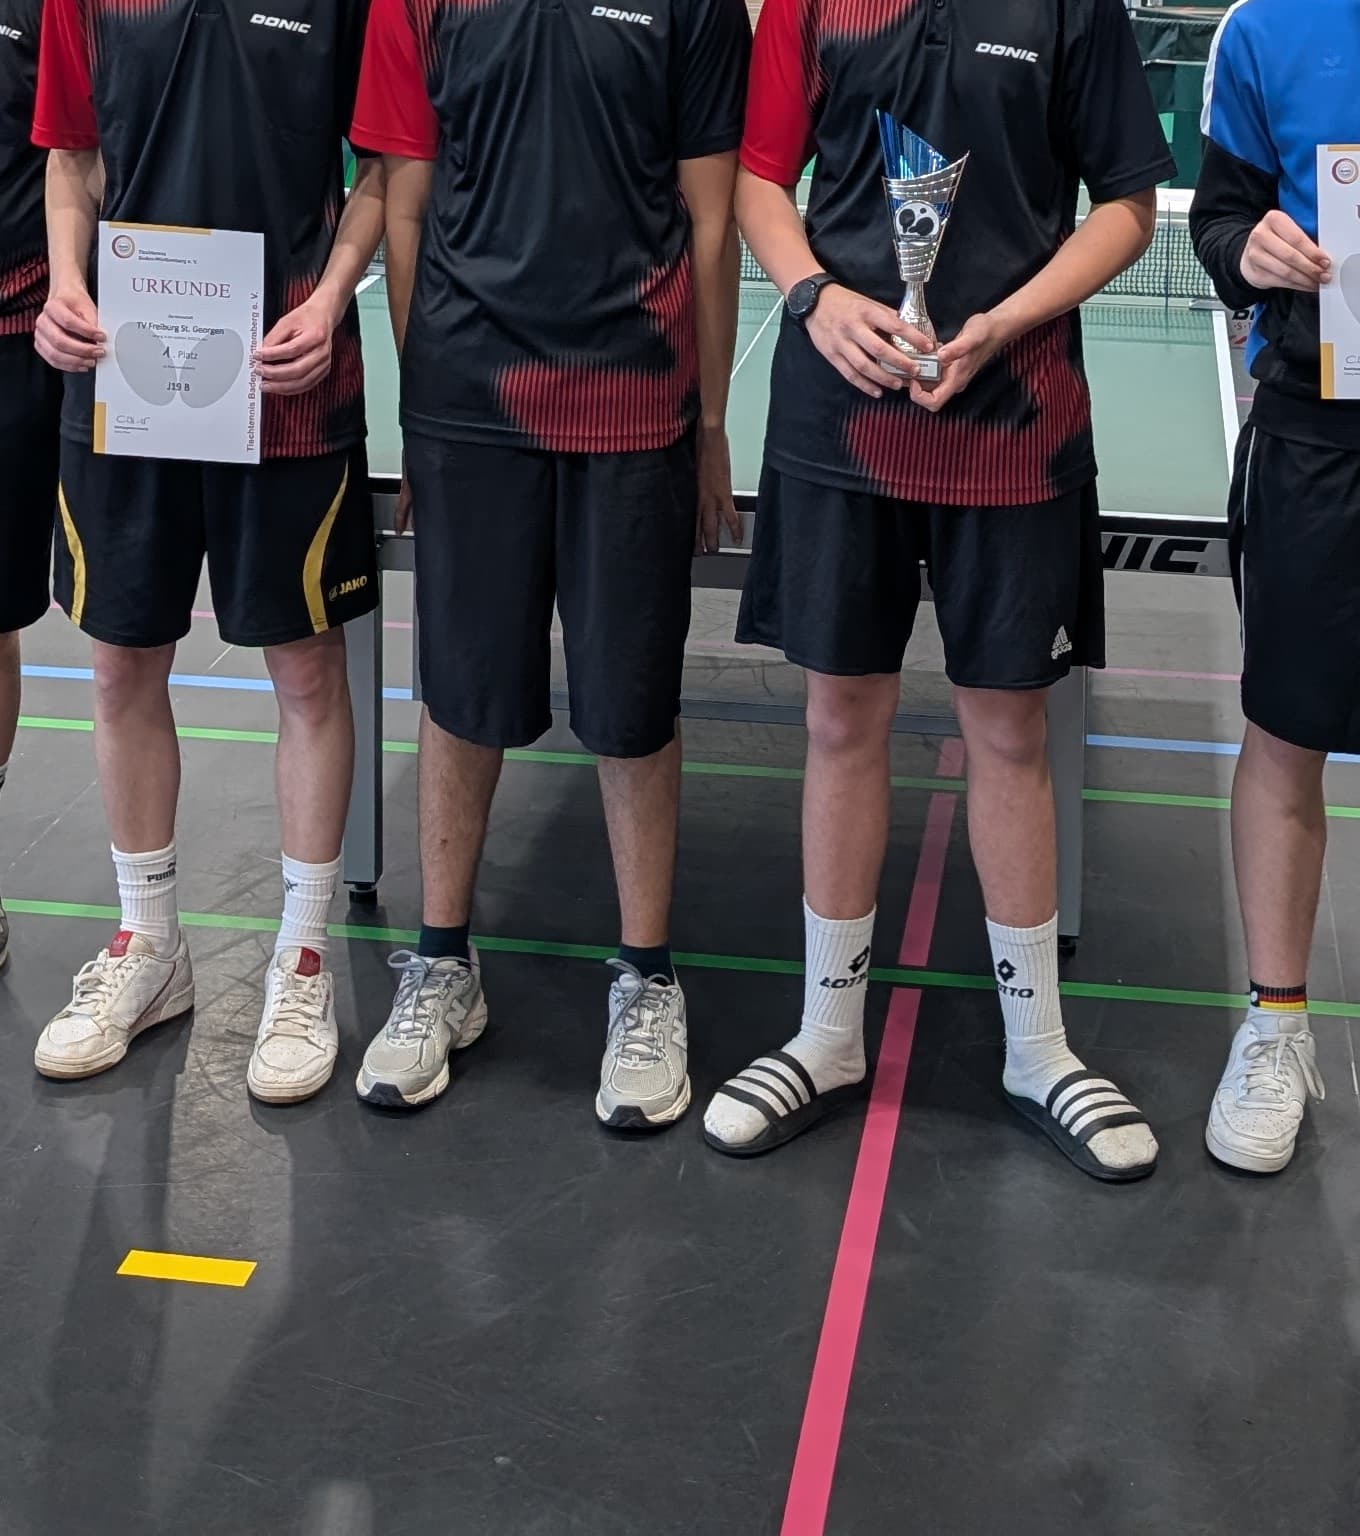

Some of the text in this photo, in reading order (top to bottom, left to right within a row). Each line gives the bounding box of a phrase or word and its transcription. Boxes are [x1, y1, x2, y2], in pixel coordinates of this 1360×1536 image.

[250, 14, 312, 34] DONIC
[591, 5, 653, 25] DONIC
[975, 42, 1039, 63] DONIC
[131, 277, 231, 299] URKUNDE
[136, 321, 147, 330] TV
[148, 323, 179, 334] Freiburg
[193, 325, 225, 336] Georgen
[178, 350, 198, 360] Platz
[166, 381, 190, 392] J19 B
[339, 575, 368, 595] JAKO
